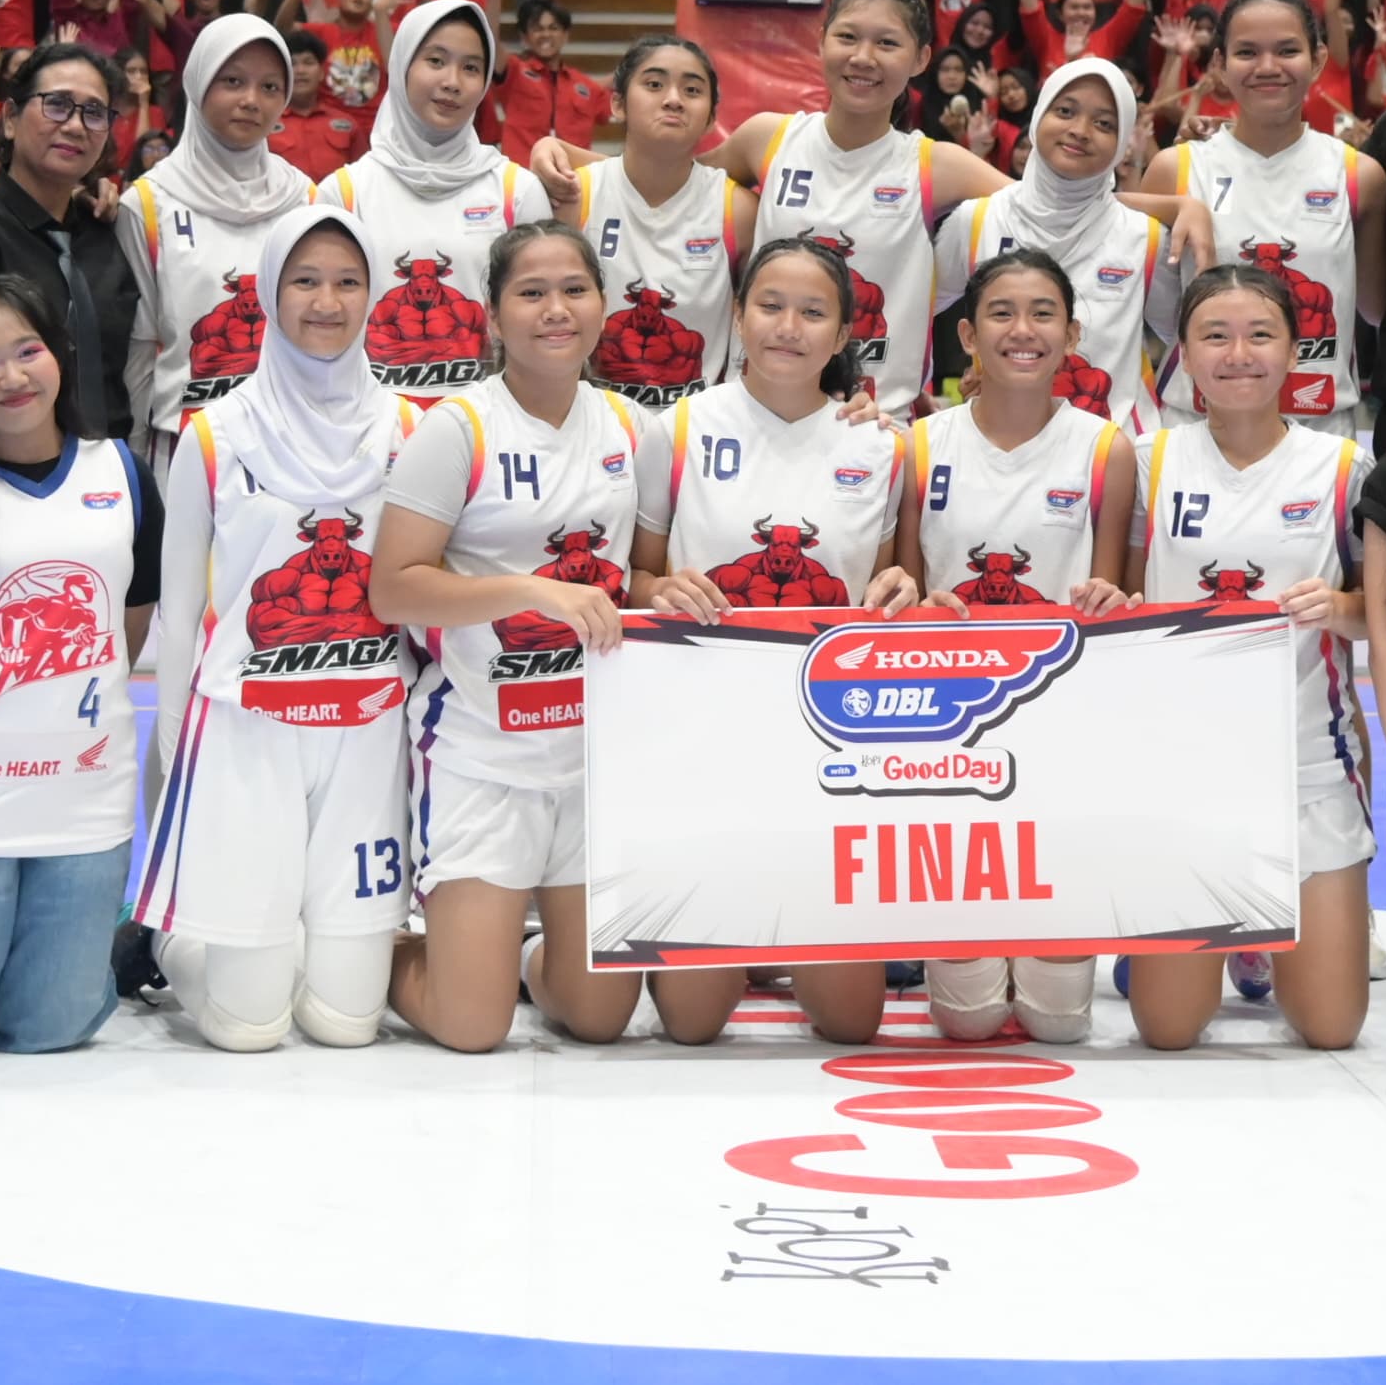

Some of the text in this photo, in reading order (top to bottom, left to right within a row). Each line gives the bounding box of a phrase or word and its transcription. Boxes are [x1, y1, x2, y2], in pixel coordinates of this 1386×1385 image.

[776, 168, 813, 207] 15
[1214, 177, 1232, 212] 7
[174, 211, 195, 247] 4
[600, 218, 621, 258] 6
[498, 453, 541, 501] 14
[702, 435, 741, 482] 10
[929, 465, 952, 512] 9
[1171, 491, 1210, 538] 12
[874, 649, 1010, 670] HONDA
[77, 677, 101, 728] 4
[286, 703, 341, 722] HEART.
[507, 702, 584, 726] One HEAR
[872, 687, 940, 717] DBL
[6, 760, 61, 777] HEART.
[830, 767, 851, 776] with
[883, 755, 949, 780] Good
[953, 754, 1002, 785] Day
[354, 836, 403, 899] 13
[832, 820, 1054, 905] FINAL
